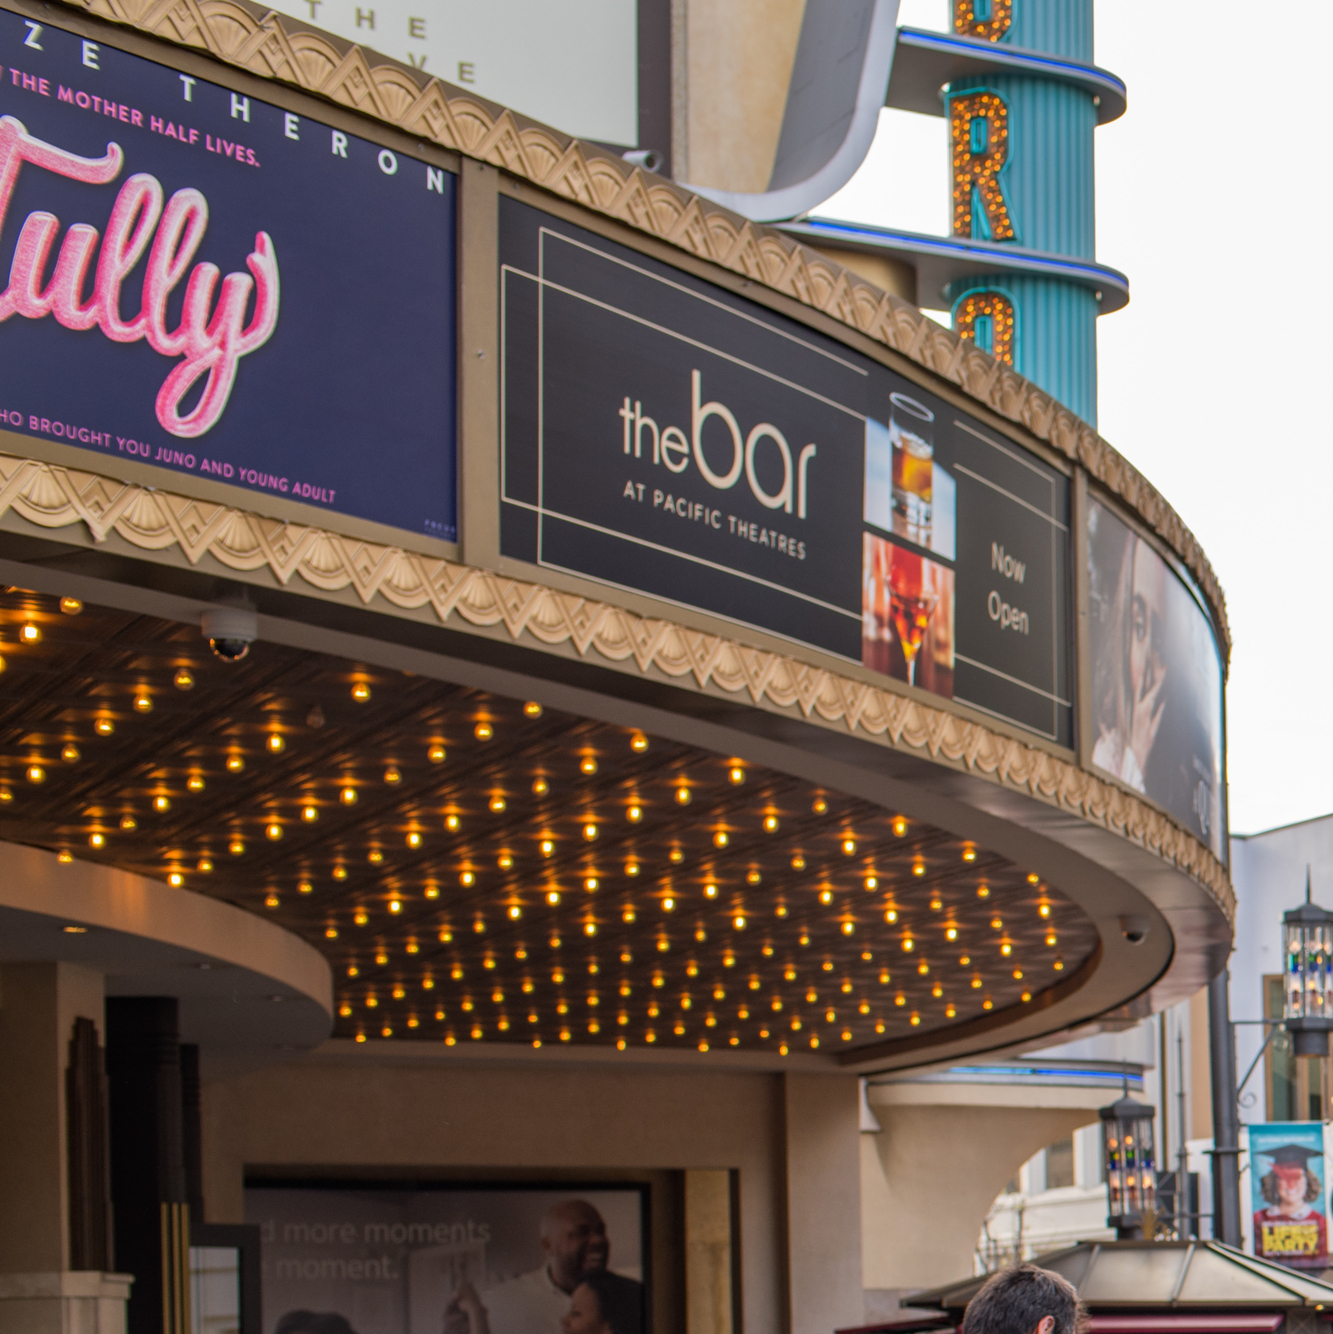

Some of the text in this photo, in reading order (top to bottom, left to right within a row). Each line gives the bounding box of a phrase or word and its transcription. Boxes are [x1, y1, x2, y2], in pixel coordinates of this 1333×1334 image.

[304, 0, 427, 40] THE
[8, 67, 261, 168] THE MOTHER HALF LIVES.
[179, 73, 445, 194] THERON
[29, 415, 112, 448] BROUGHT
[116, 436, 150, 458] YOU
[155, 447, 197, 469] JUNO
[200, 458, 235, 479] AND
[238, 467, 289, 493] YOUNG
[292, 481, 336, 504] ADULT
[623, 480, 807, 561] AT PACIFIC THEATRES
[991, 541, 1026, 585] Now
[987, 590, 1029, 636] Open
[284, 1220, 355, 1244] more
[364, 1218, 492, 1244] moments
[276, 1254, 400, 1281] moment.
